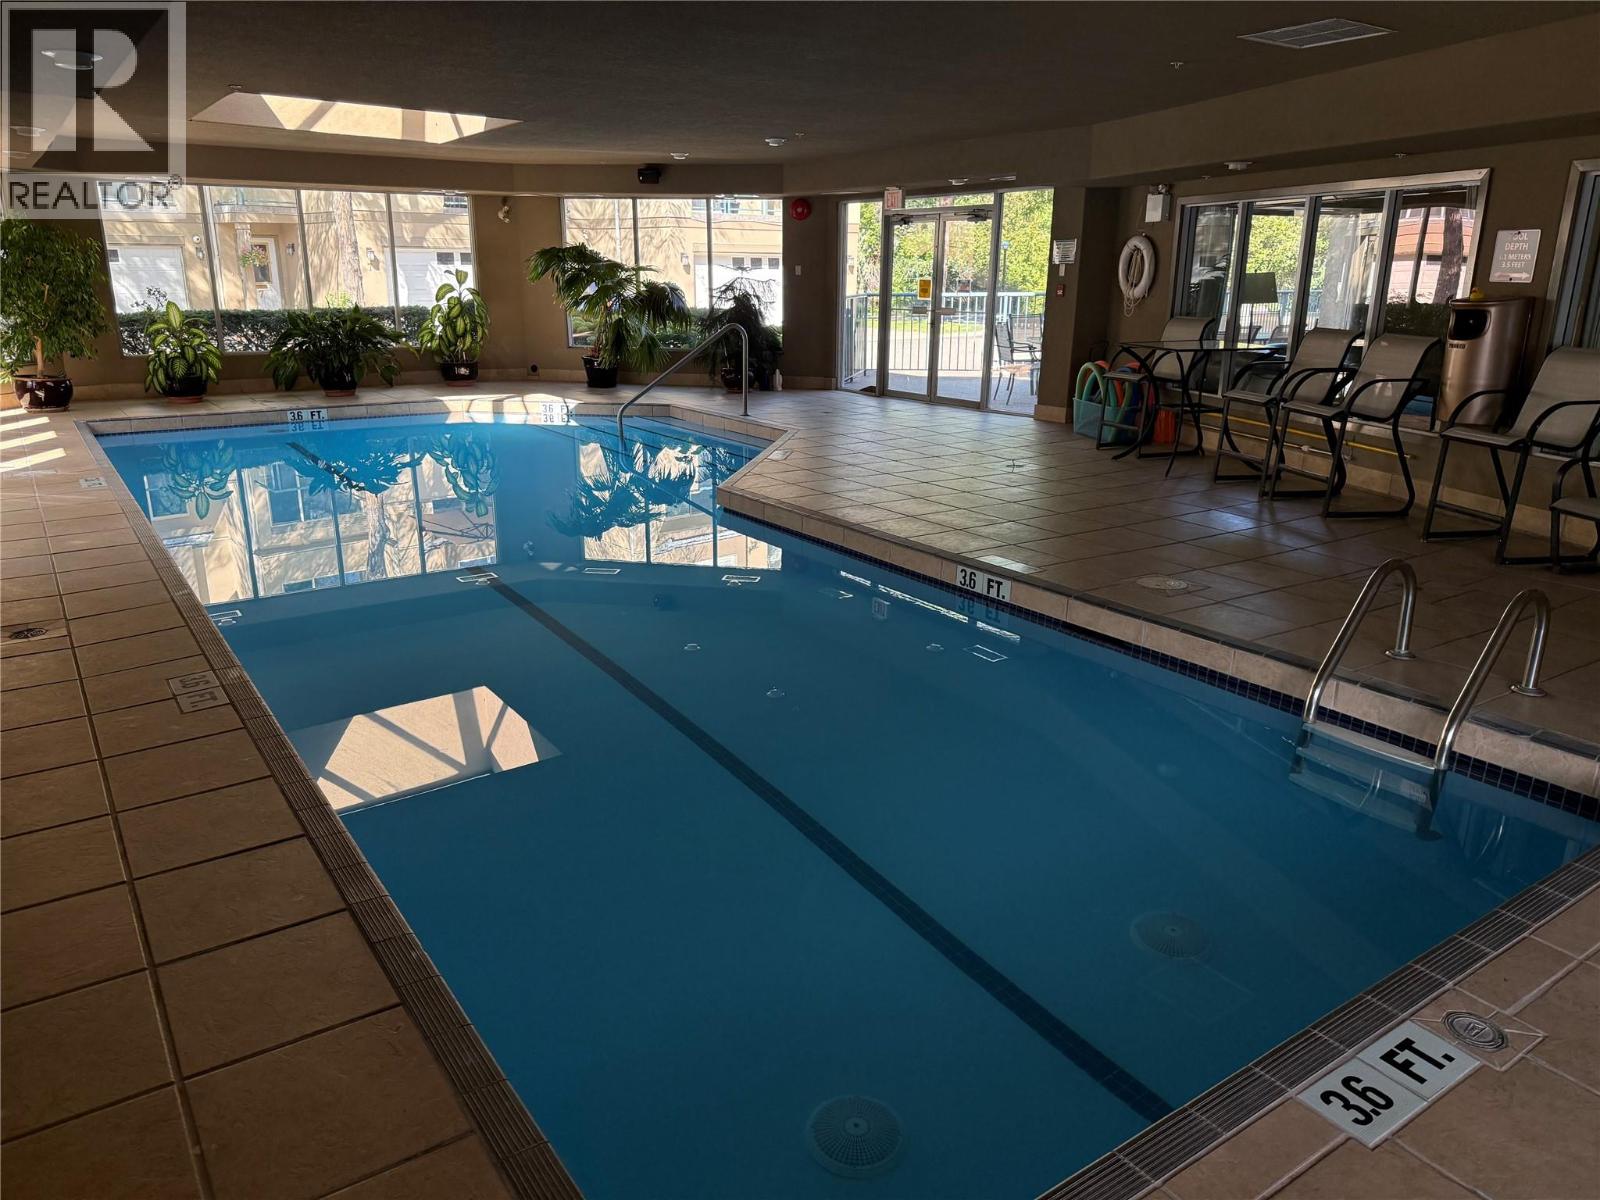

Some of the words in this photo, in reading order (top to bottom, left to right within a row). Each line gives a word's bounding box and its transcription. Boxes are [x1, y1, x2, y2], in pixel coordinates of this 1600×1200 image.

[1504, 242, 1529, 251] DEPTH
[289, 411, 304, 421] 3.6
[310, 410, 325, 420] FT.
[959, 568, 977, 590] 3.6
[986, 577, 1006, 600] FT.
[1319, 1075, 1395, 1127] 3.6
[1378, 1036, 1456, 1086] FT.
